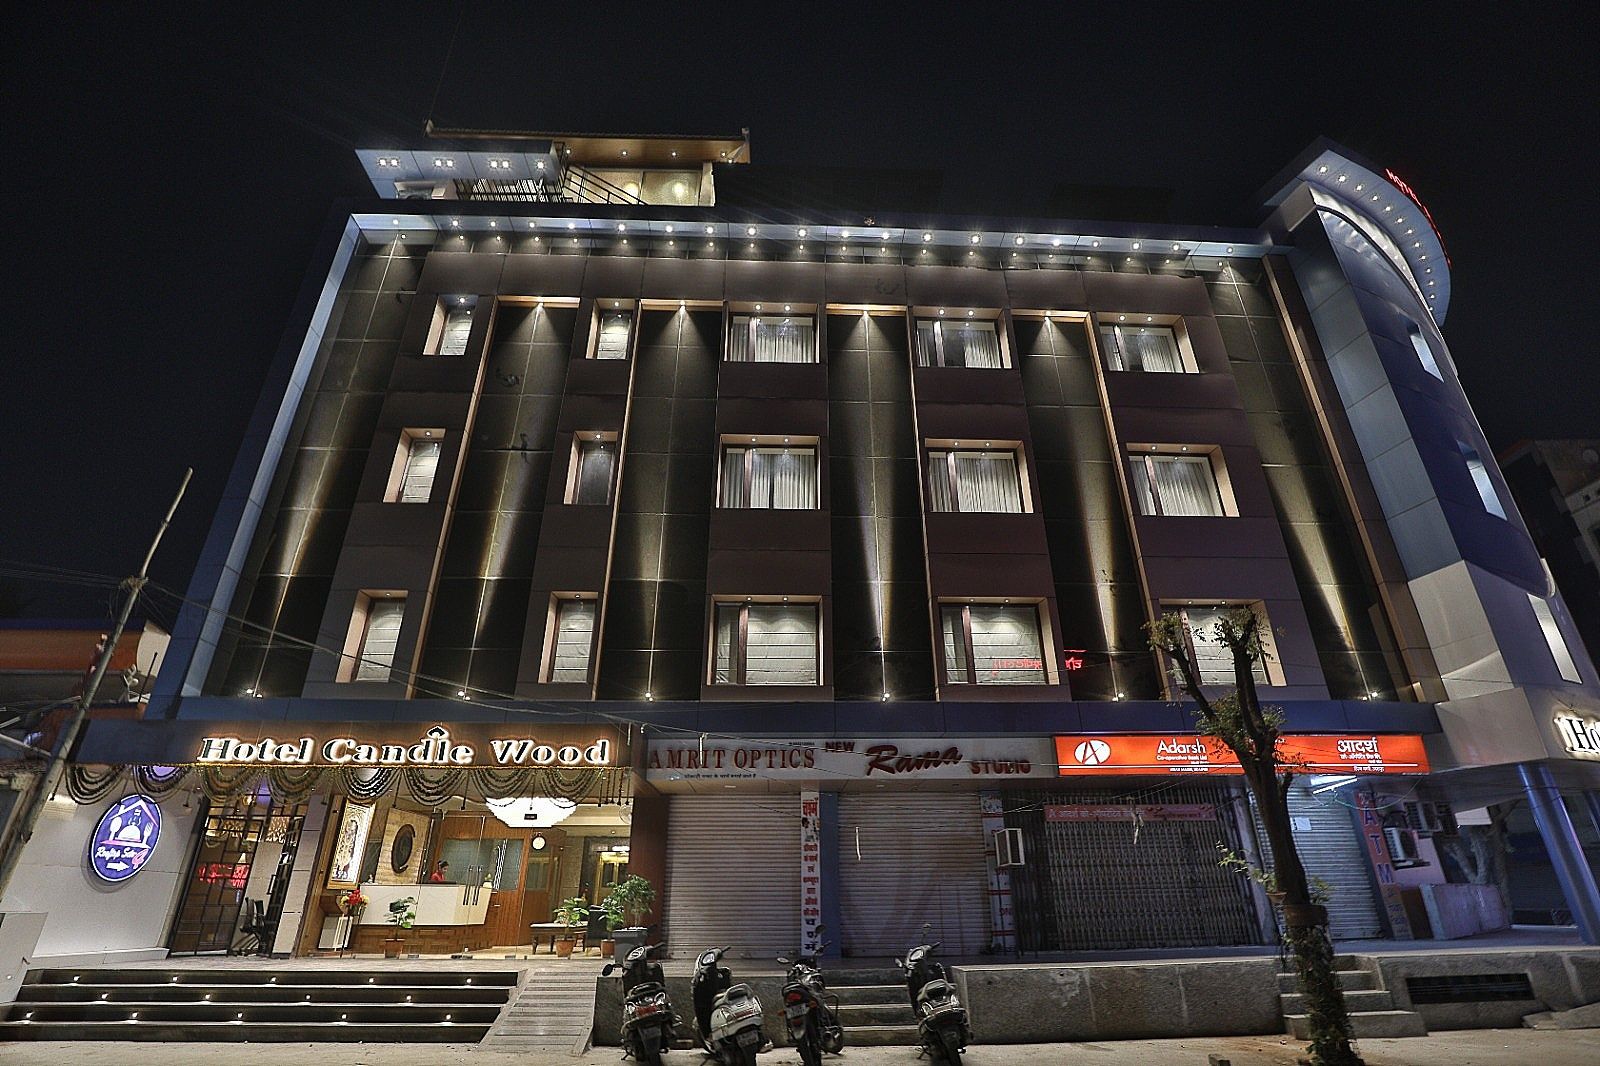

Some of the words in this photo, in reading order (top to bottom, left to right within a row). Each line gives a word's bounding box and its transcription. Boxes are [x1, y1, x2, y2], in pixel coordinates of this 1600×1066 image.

[197, 737, 315, 765] Hotel
[322, 726, 474, 765] Candle
[489, 738, 610, 765] Wood
[826, 741, 856, 753] NEW
[1157, 738, 1206, 754] Adarsh
[1338, 737, 1378, 753] आदर्श
[650, 750, 724, 769] AMRIT
[733, 749, 815, 768] OPTICS
[866, 745, 963, 776] Rama
[971, 759, 1032, 774] STUDIO
[1363, 805, 1394, 884] ATM
